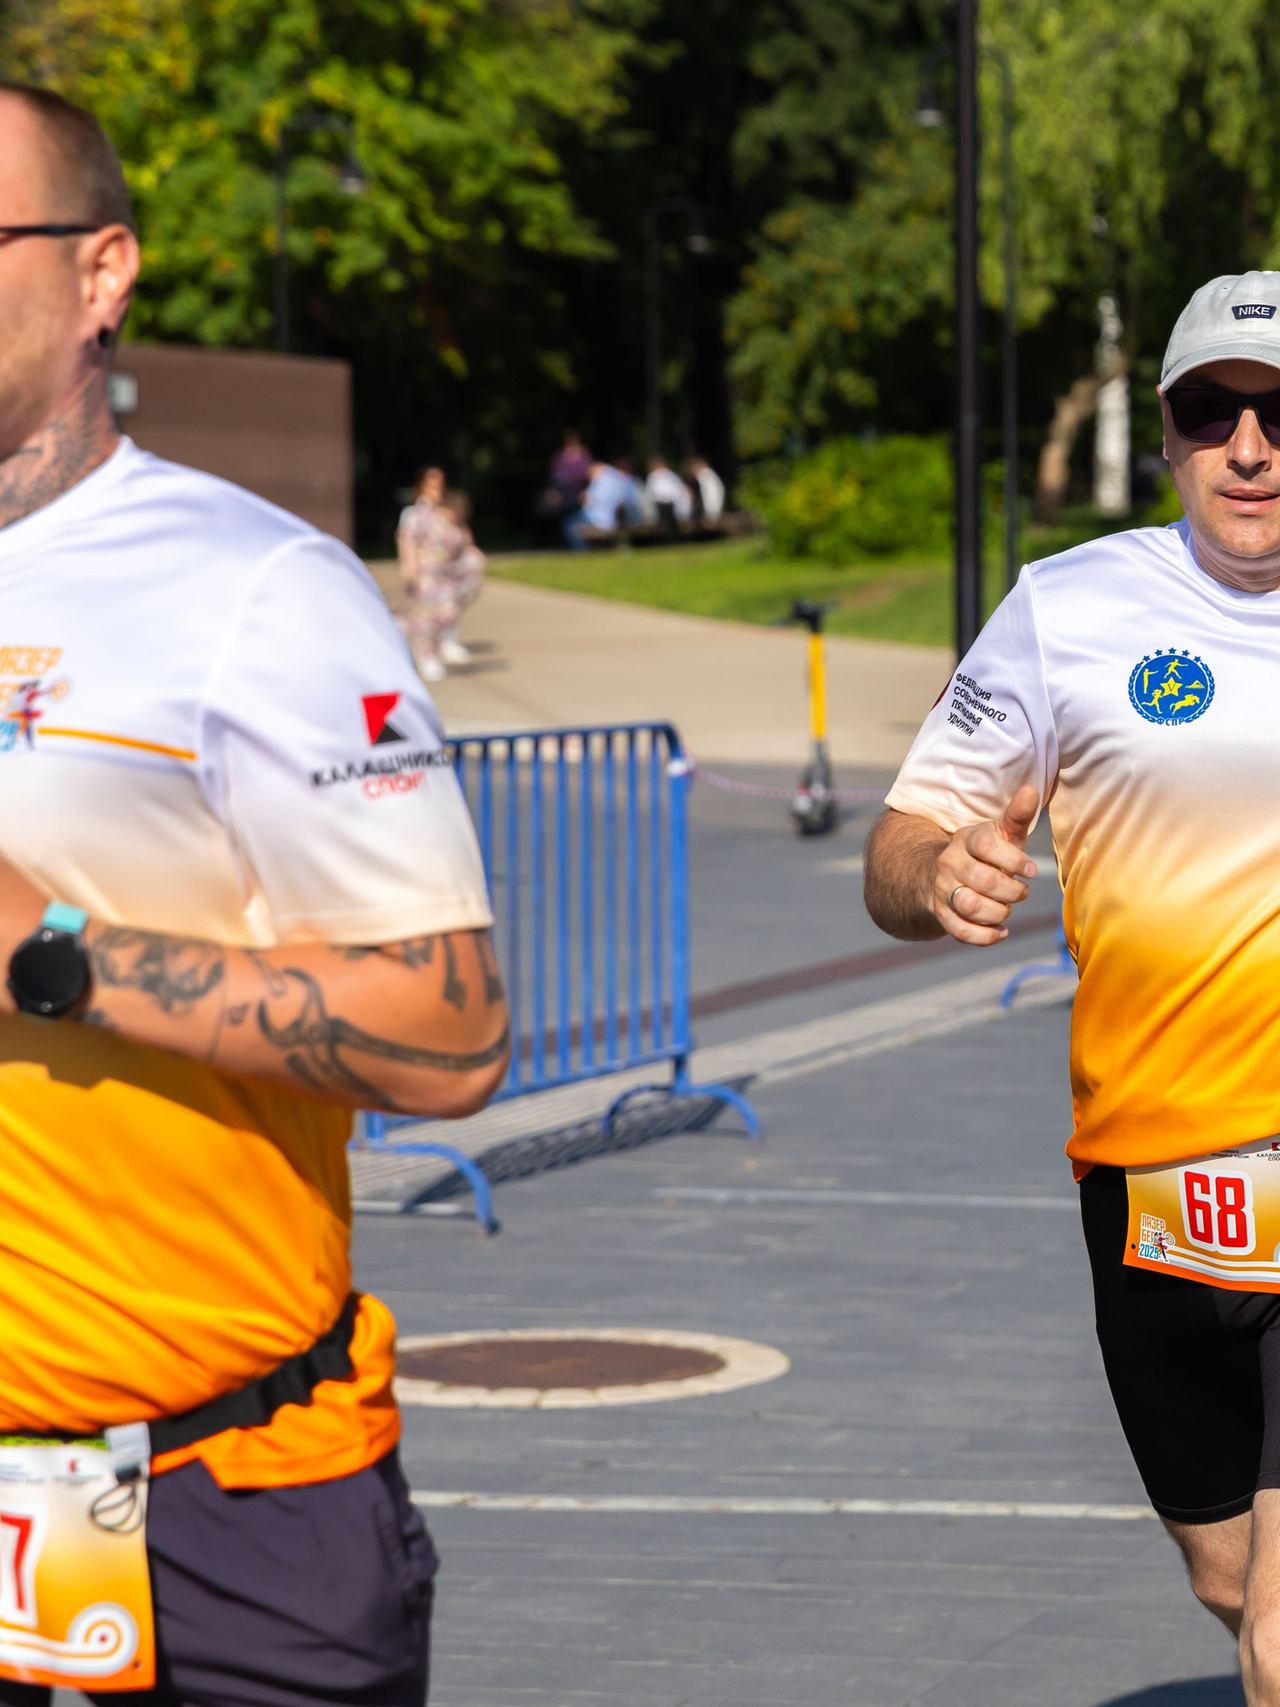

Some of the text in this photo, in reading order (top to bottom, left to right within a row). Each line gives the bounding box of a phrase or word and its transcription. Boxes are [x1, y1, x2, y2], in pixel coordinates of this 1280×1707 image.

[1239, 306, 1270, 316] NIKE
[1156, 717, 1185, 726] ФСПР
[1184, 1171, 1248, 1248] 68
[1142, 1214, 1165, 1232] ЛАЗЕР
[1140, 1243, 1159, 1260] 2025
